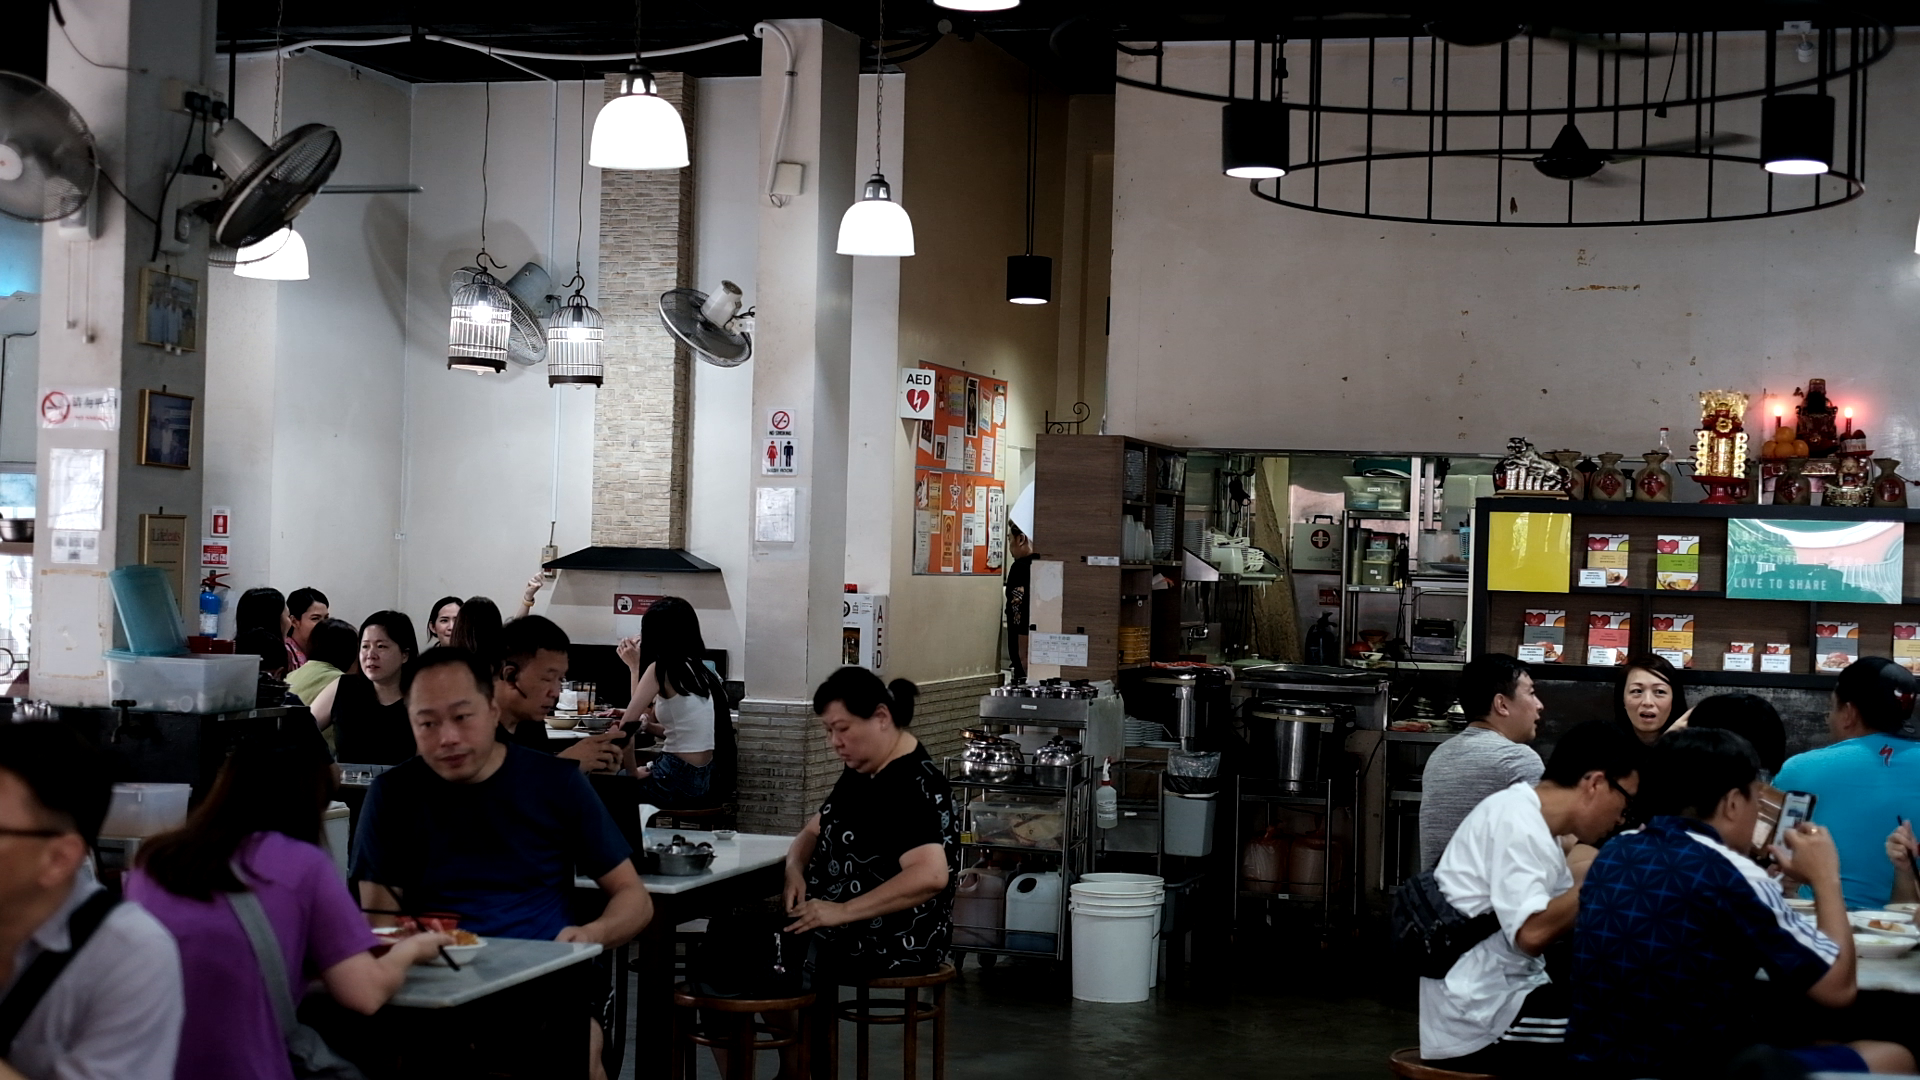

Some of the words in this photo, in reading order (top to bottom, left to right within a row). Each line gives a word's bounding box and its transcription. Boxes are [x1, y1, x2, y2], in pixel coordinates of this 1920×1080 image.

[906, 373, 932, 386] AED
[1734, 578, 1763, 589] LOVE
[1769, 578, 1782, 590] TO
[1789, 579, 1827, 591] SHARE
